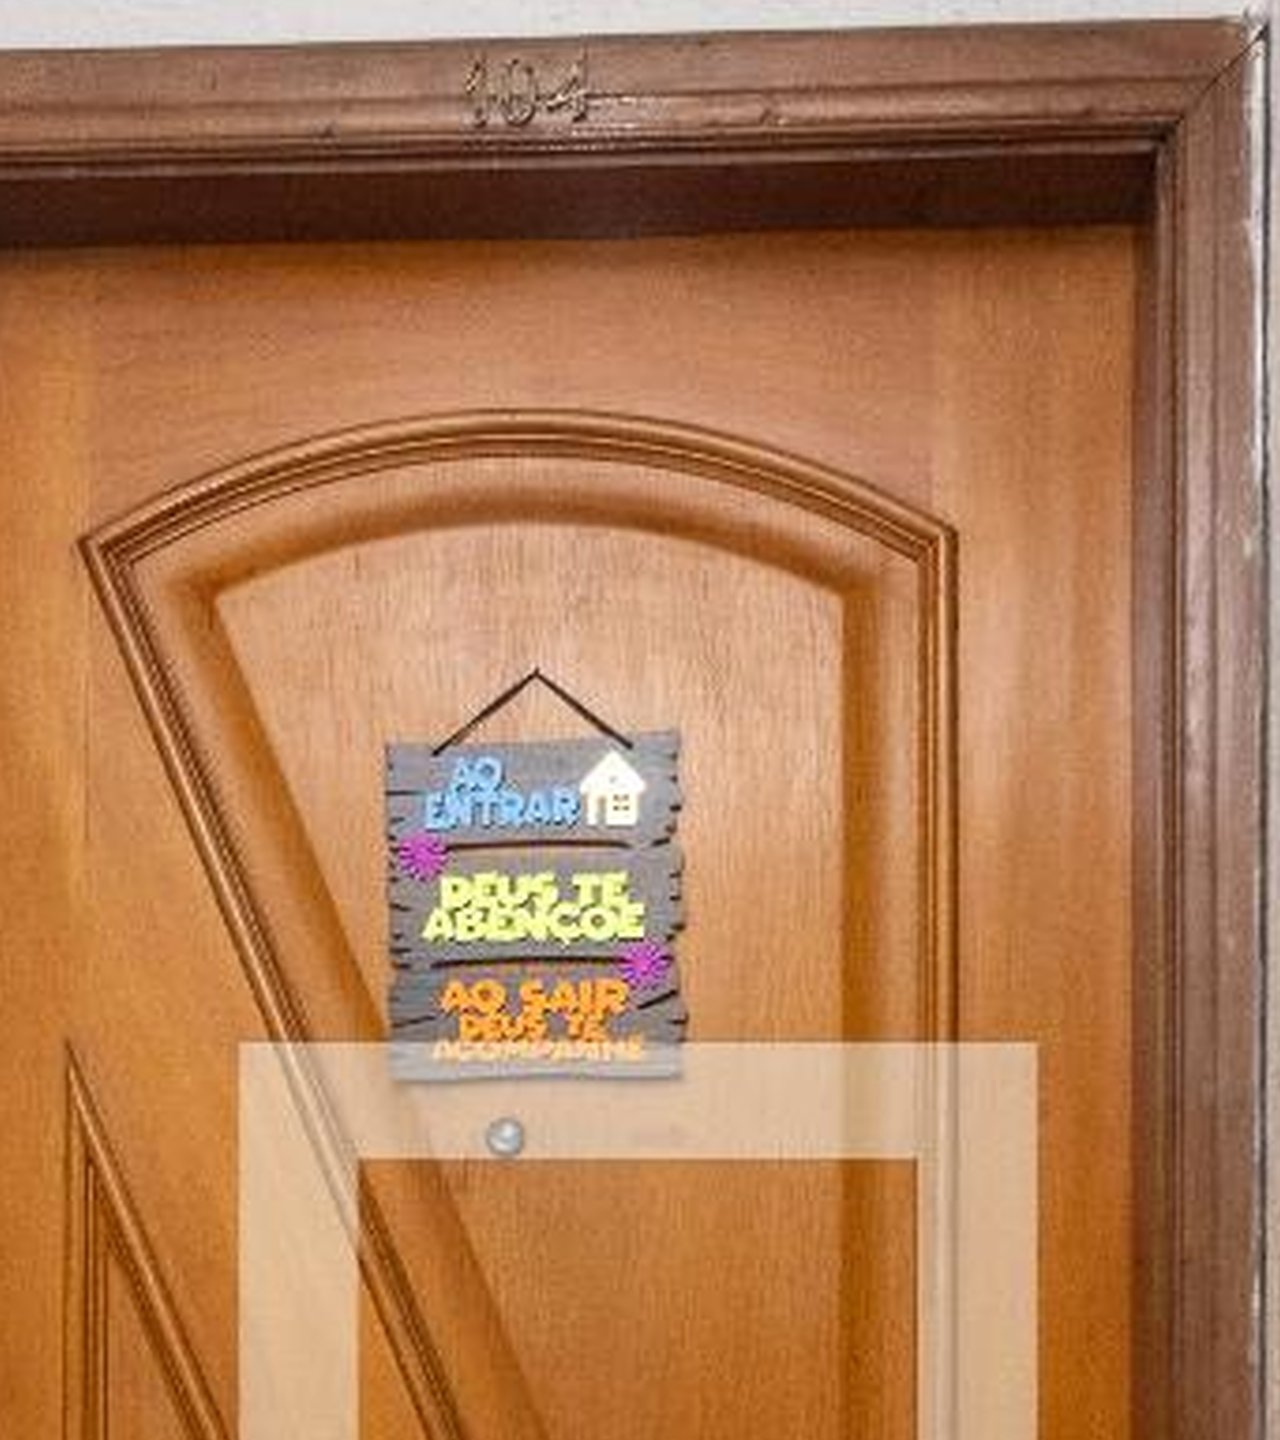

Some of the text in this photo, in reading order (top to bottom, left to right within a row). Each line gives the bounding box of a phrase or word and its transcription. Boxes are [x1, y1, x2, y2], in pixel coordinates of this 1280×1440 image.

[451, 758, 502, 793] AO
[426, 787, 579, 829] ENTRAR
[441, 873, 629, 908] DEUS TE
[422, 903, 645, 948] ABENÇOE
[440, 979, 628, 1013] AO SAIR
[459, 1012, 609, 1042] DEUS TE
